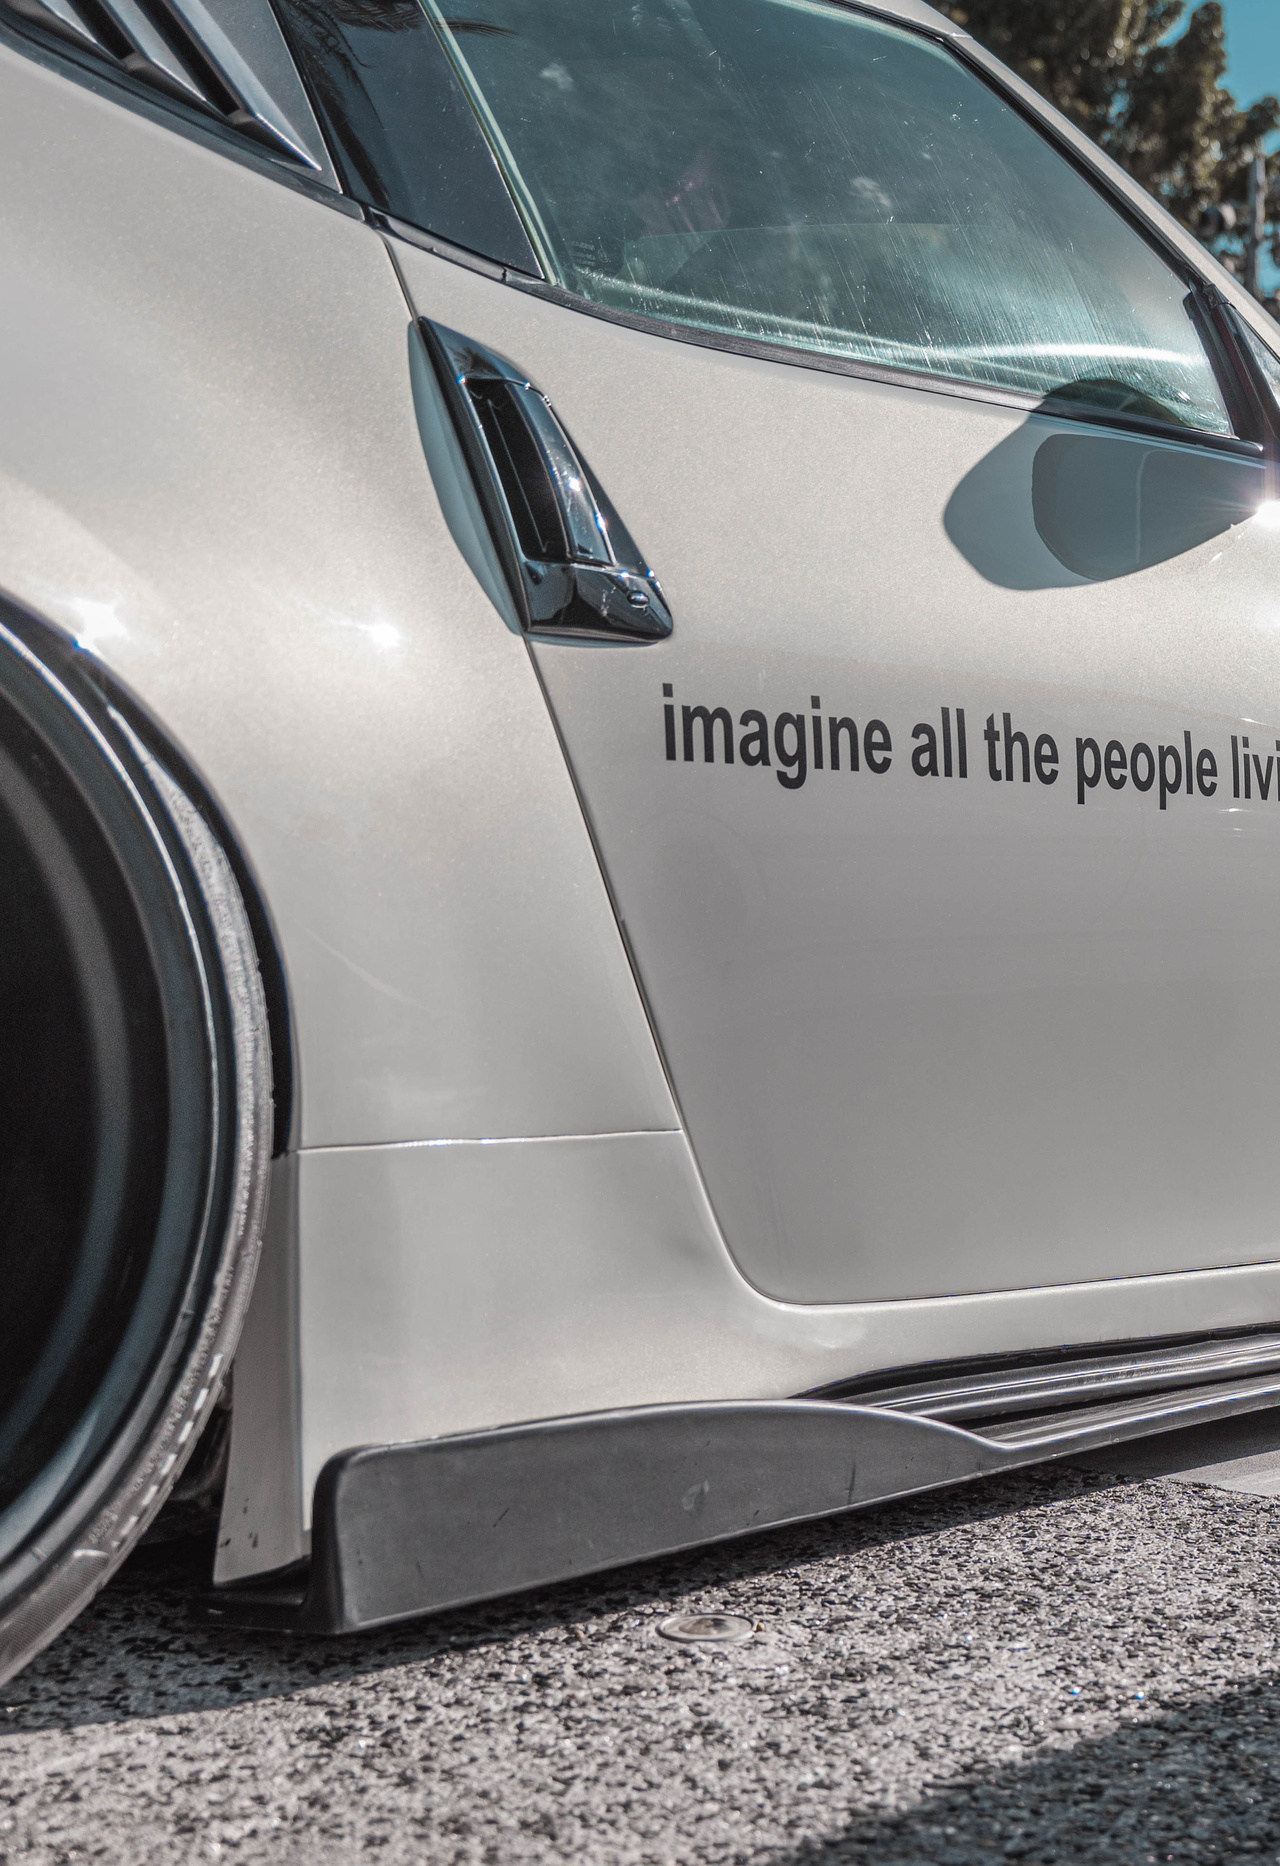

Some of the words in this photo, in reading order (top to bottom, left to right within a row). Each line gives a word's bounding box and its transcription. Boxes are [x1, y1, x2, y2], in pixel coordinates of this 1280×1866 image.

[662, 682, 893, 790] imagine
[910, 706, 968, 779] all
[983, 712, 1060, 786] the
[1075, 730, 1218, 811] people
